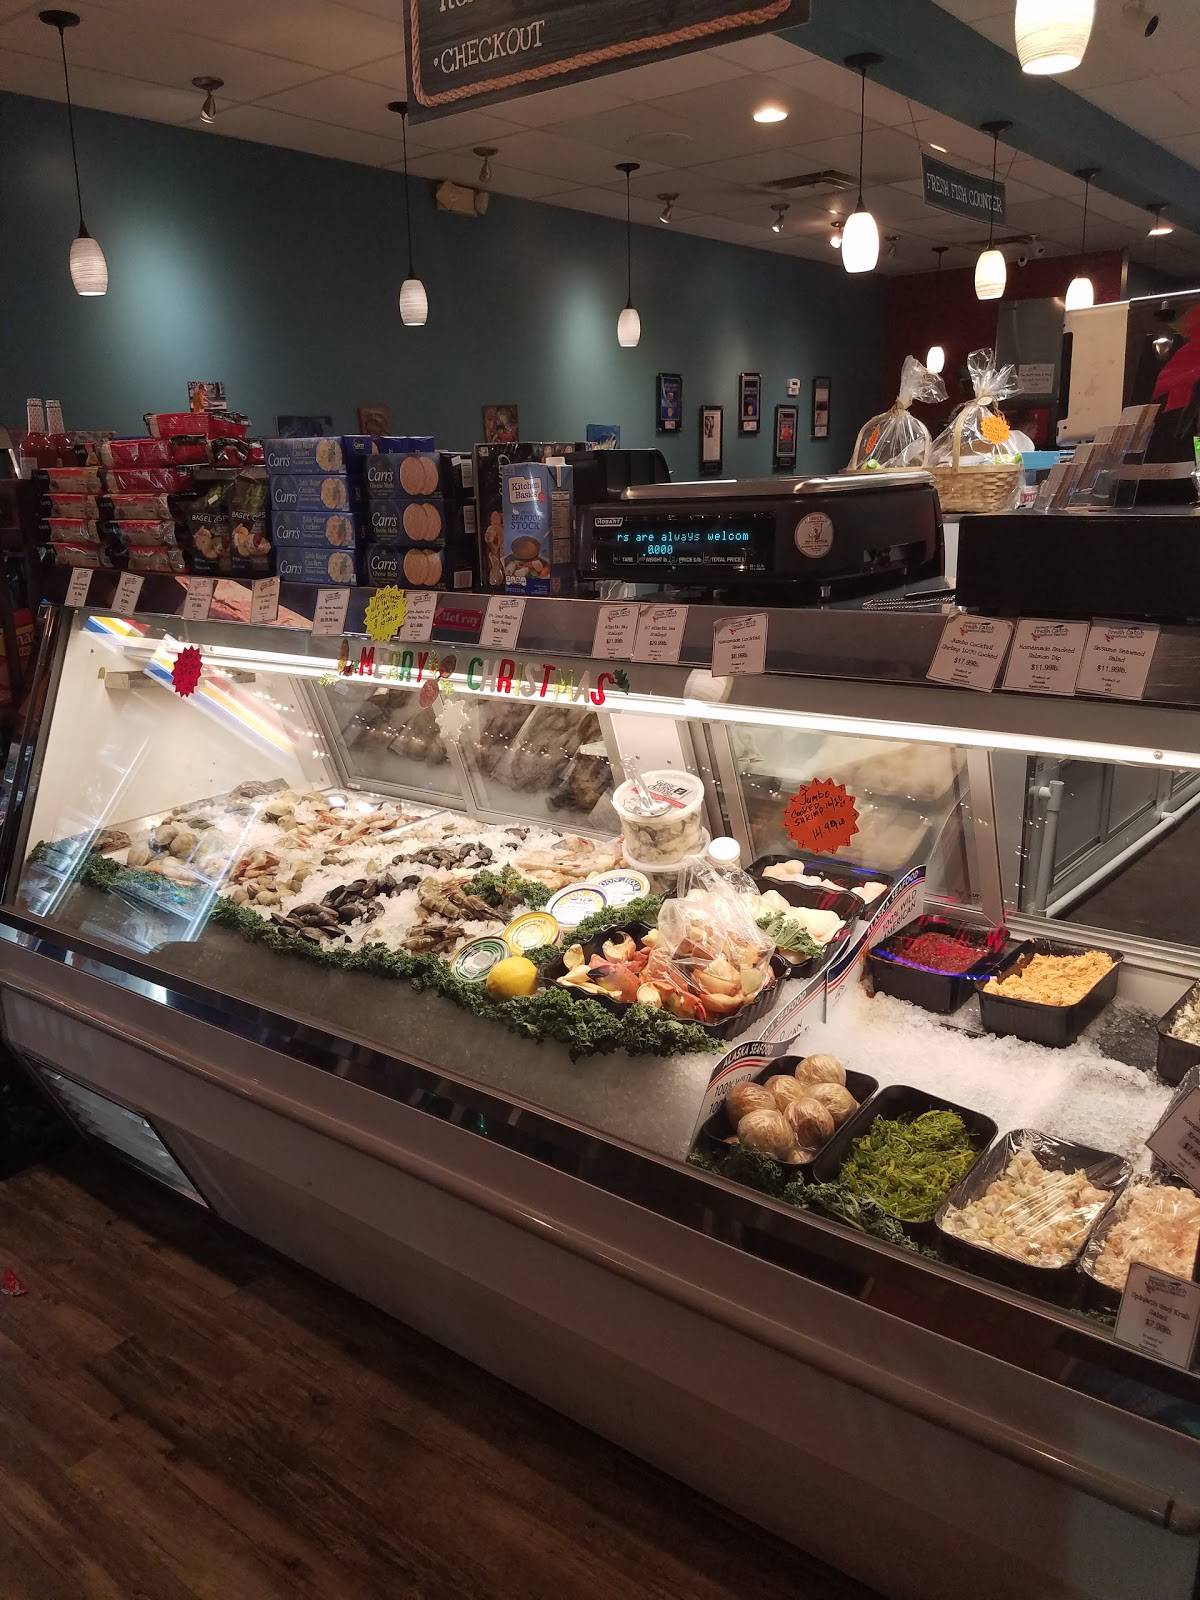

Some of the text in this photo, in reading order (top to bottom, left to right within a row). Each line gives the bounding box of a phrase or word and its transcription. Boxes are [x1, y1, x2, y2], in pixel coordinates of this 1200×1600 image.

[440, 20, 545, 74] CHECKOUT
[926, 173, 1003, 214] FRESH FISH COUNTER
[268, 453, 291, 467] Carr's
[368, 467, 394, 482] Carr's
[511, 481, 540, 491] Kitchen
[275, 489, 297, 503] Carr's
[515, 491, 538, 499] Basics
[192, 514, 212, 523] BAGEL
[232, 511, 250, 519] BAGEL
[372, 511, 397, 527] Carr's
[276, 525, 300, 539] Carr's
[511, 522, 540, 530] STOCK
[617, 530, 749, 544] rs are always welcom
[280, 560, 302, 574] Carr's
[371, 555, 397, 570] Carr's
[941, 643, 961, 653] Shrimp
[978, 651, 999, 660] Cooked
[950, 638, 994, 651] Jumbo Cocktail
[1019, 644, 1051, 652] Homemade
[1093, 644, 1146, 657] Sesame Seaweed
[1028, 652, 1062, 662] Salmon Dip
[1107, 655, 1126, 663] Salad
[359, 645, 615, 706] MERRY CHRISTMAS
[794, 806, 824, 827] SHRIMP
[891, 869, 919, 899] SEAFOOD
[899, 889, 917, 911] WILD
[722, 1042, 774, 1069] ALASKA SEAFOOD
